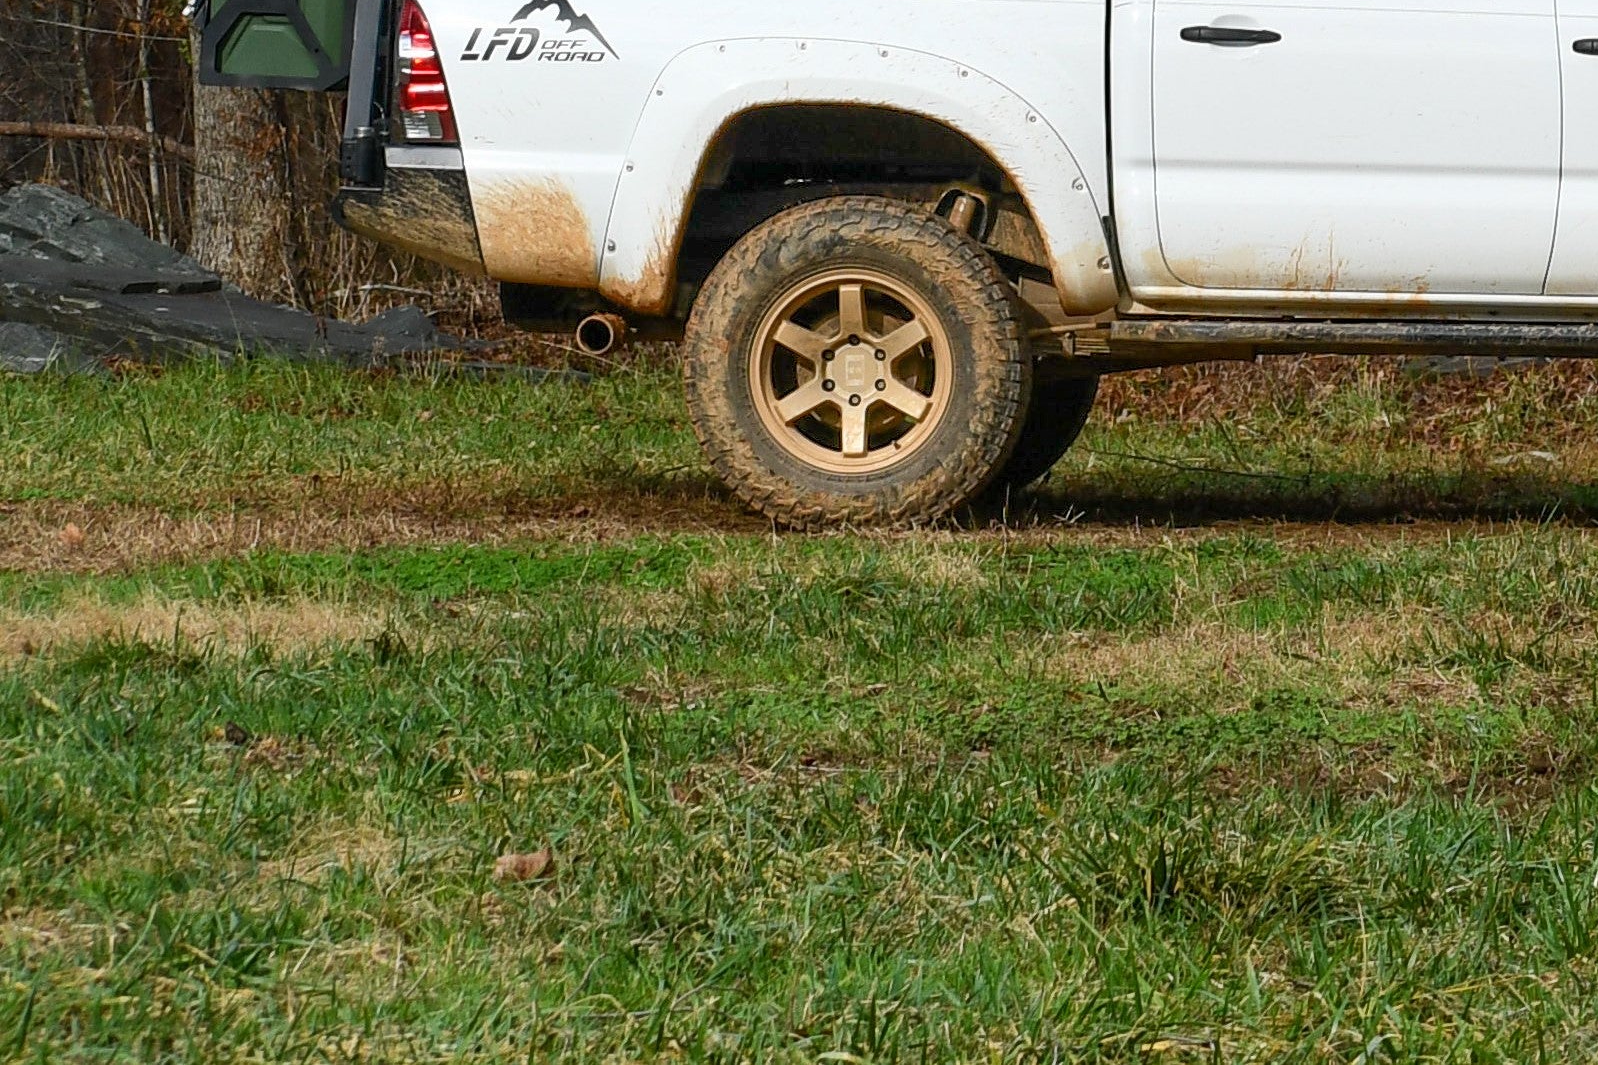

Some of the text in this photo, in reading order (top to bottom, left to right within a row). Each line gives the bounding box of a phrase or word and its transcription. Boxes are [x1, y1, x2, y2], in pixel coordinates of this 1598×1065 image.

[460, 28, 540, 61] LFD
[541, 40, 586, 49] OFF
[538, 51, 605, 62] ROAD
